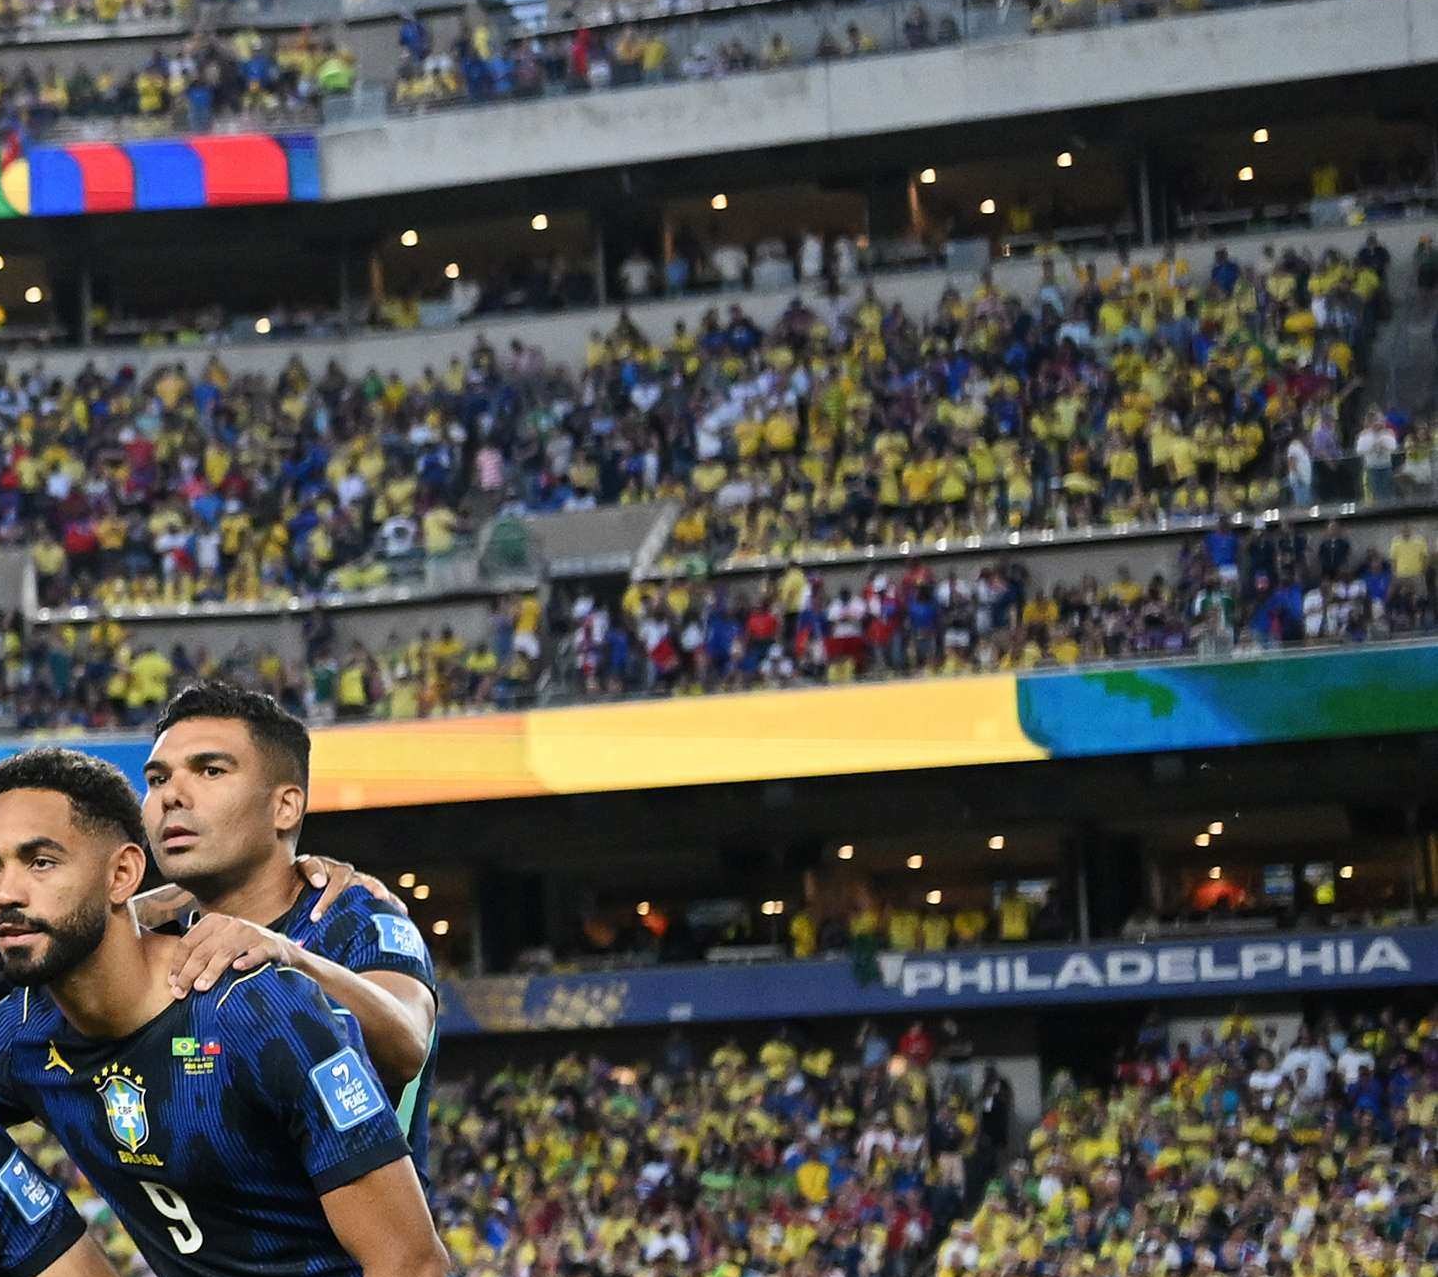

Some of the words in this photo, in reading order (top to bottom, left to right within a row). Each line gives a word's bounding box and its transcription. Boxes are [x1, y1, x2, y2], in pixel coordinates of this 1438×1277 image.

[902, 935, 1411, 999] PHILADELPHIA
[117, 1150, 164, 1167] BRASIL
[138, 1181, 202, 1255] 9
